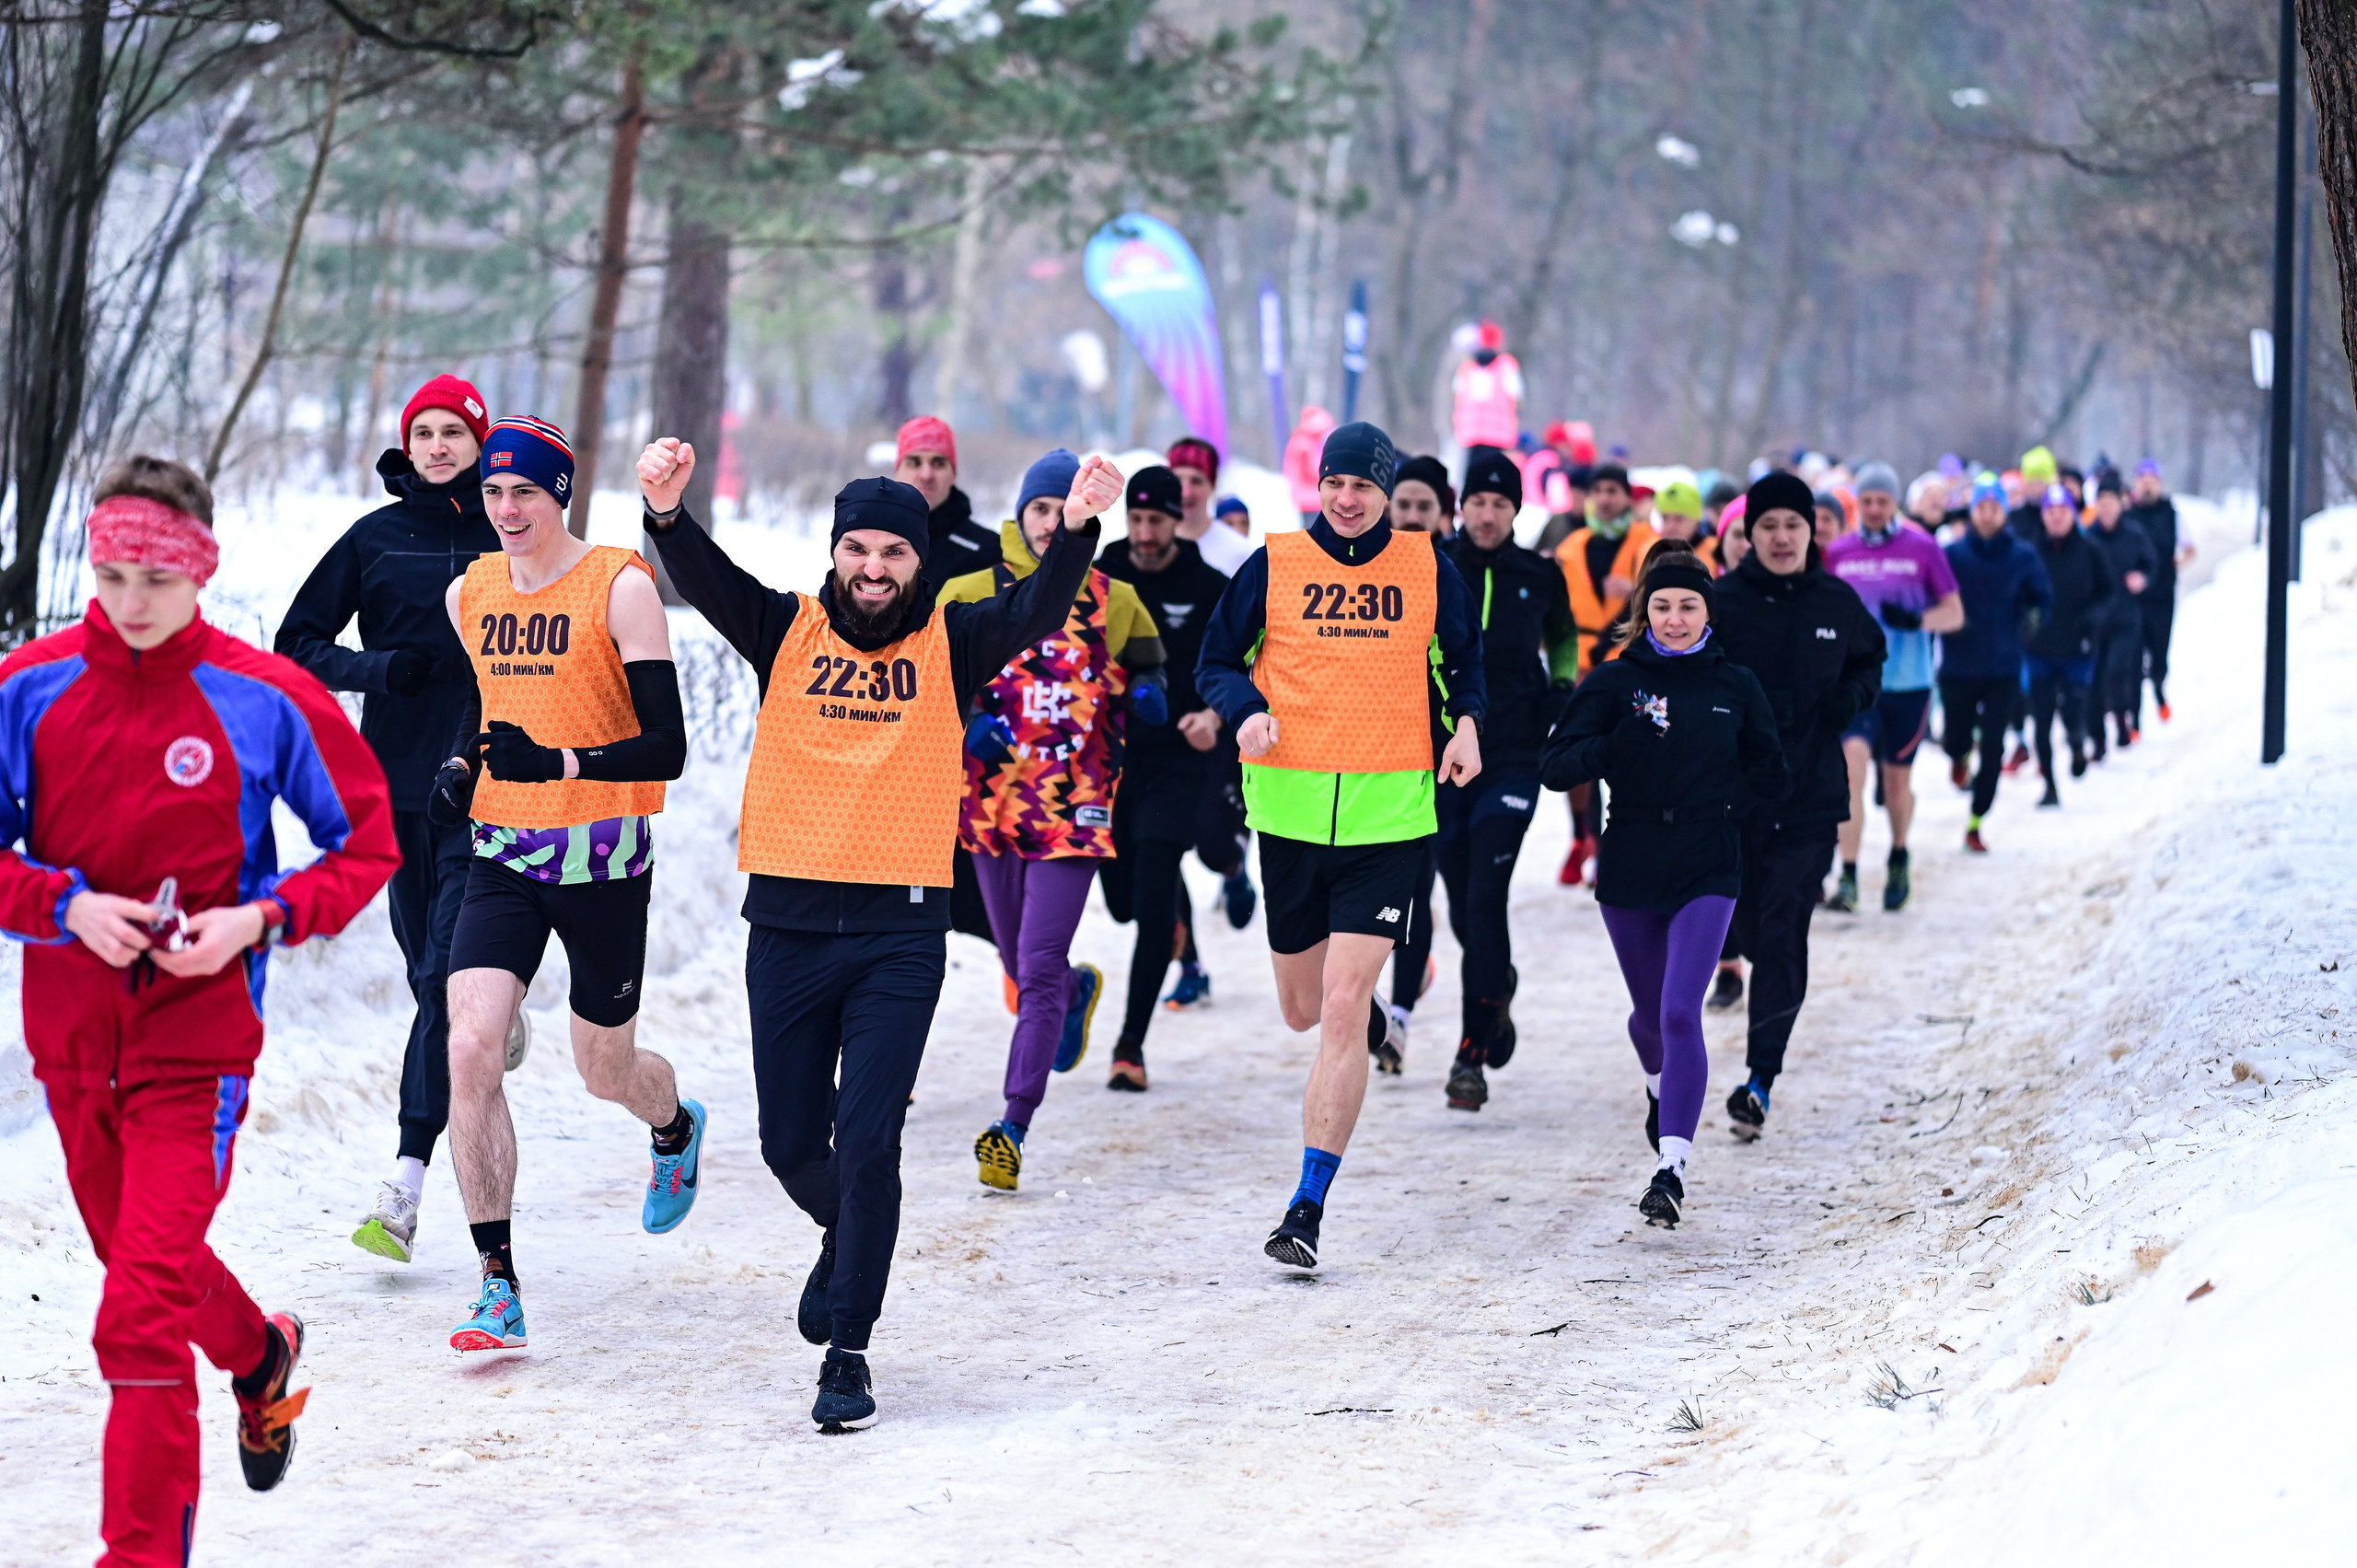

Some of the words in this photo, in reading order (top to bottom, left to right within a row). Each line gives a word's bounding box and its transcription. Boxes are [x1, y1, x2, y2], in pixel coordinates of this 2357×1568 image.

[1302, 583, 1403, 622] 22:30
[481, 612, 571, 656] 20:00
[1317, 626, 1341, 638] 4:30
[1343, 627, 1389, 639] мин/км
[491, 663, 511, 676] 4:00
[513, 662, 555, 677] мин/км
[806, 655, 917, 702] 22:30
[819, 703, 846, 720] 4:30
[849, 709, 901, 723] мин/км
[1376, 906, 1401, 923] NB
